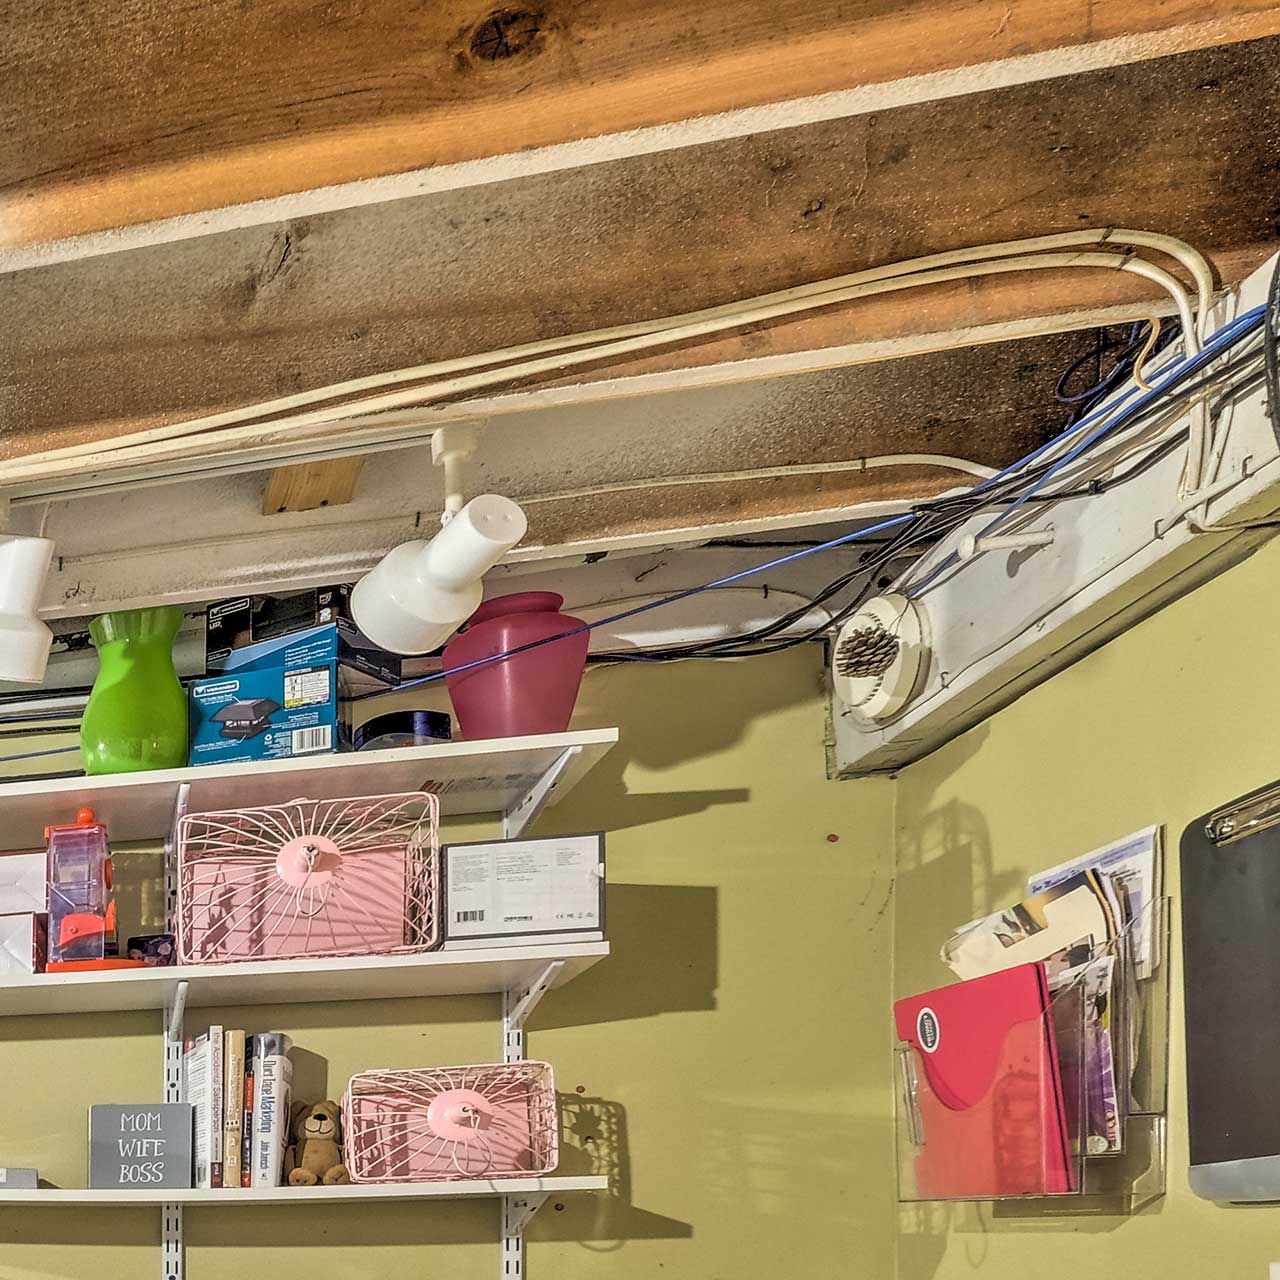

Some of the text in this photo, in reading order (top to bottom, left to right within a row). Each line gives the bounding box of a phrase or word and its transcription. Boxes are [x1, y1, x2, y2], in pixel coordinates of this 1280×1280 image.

[211, 1086, 221, 1133] Salesperson
[257, 1096, 276, 1133] Marketing
[120, 1112, 162, 1132] MOM
[118, 1138, 166, 1157] WIFE
[119, 1161, 165, 1183] BOSS
